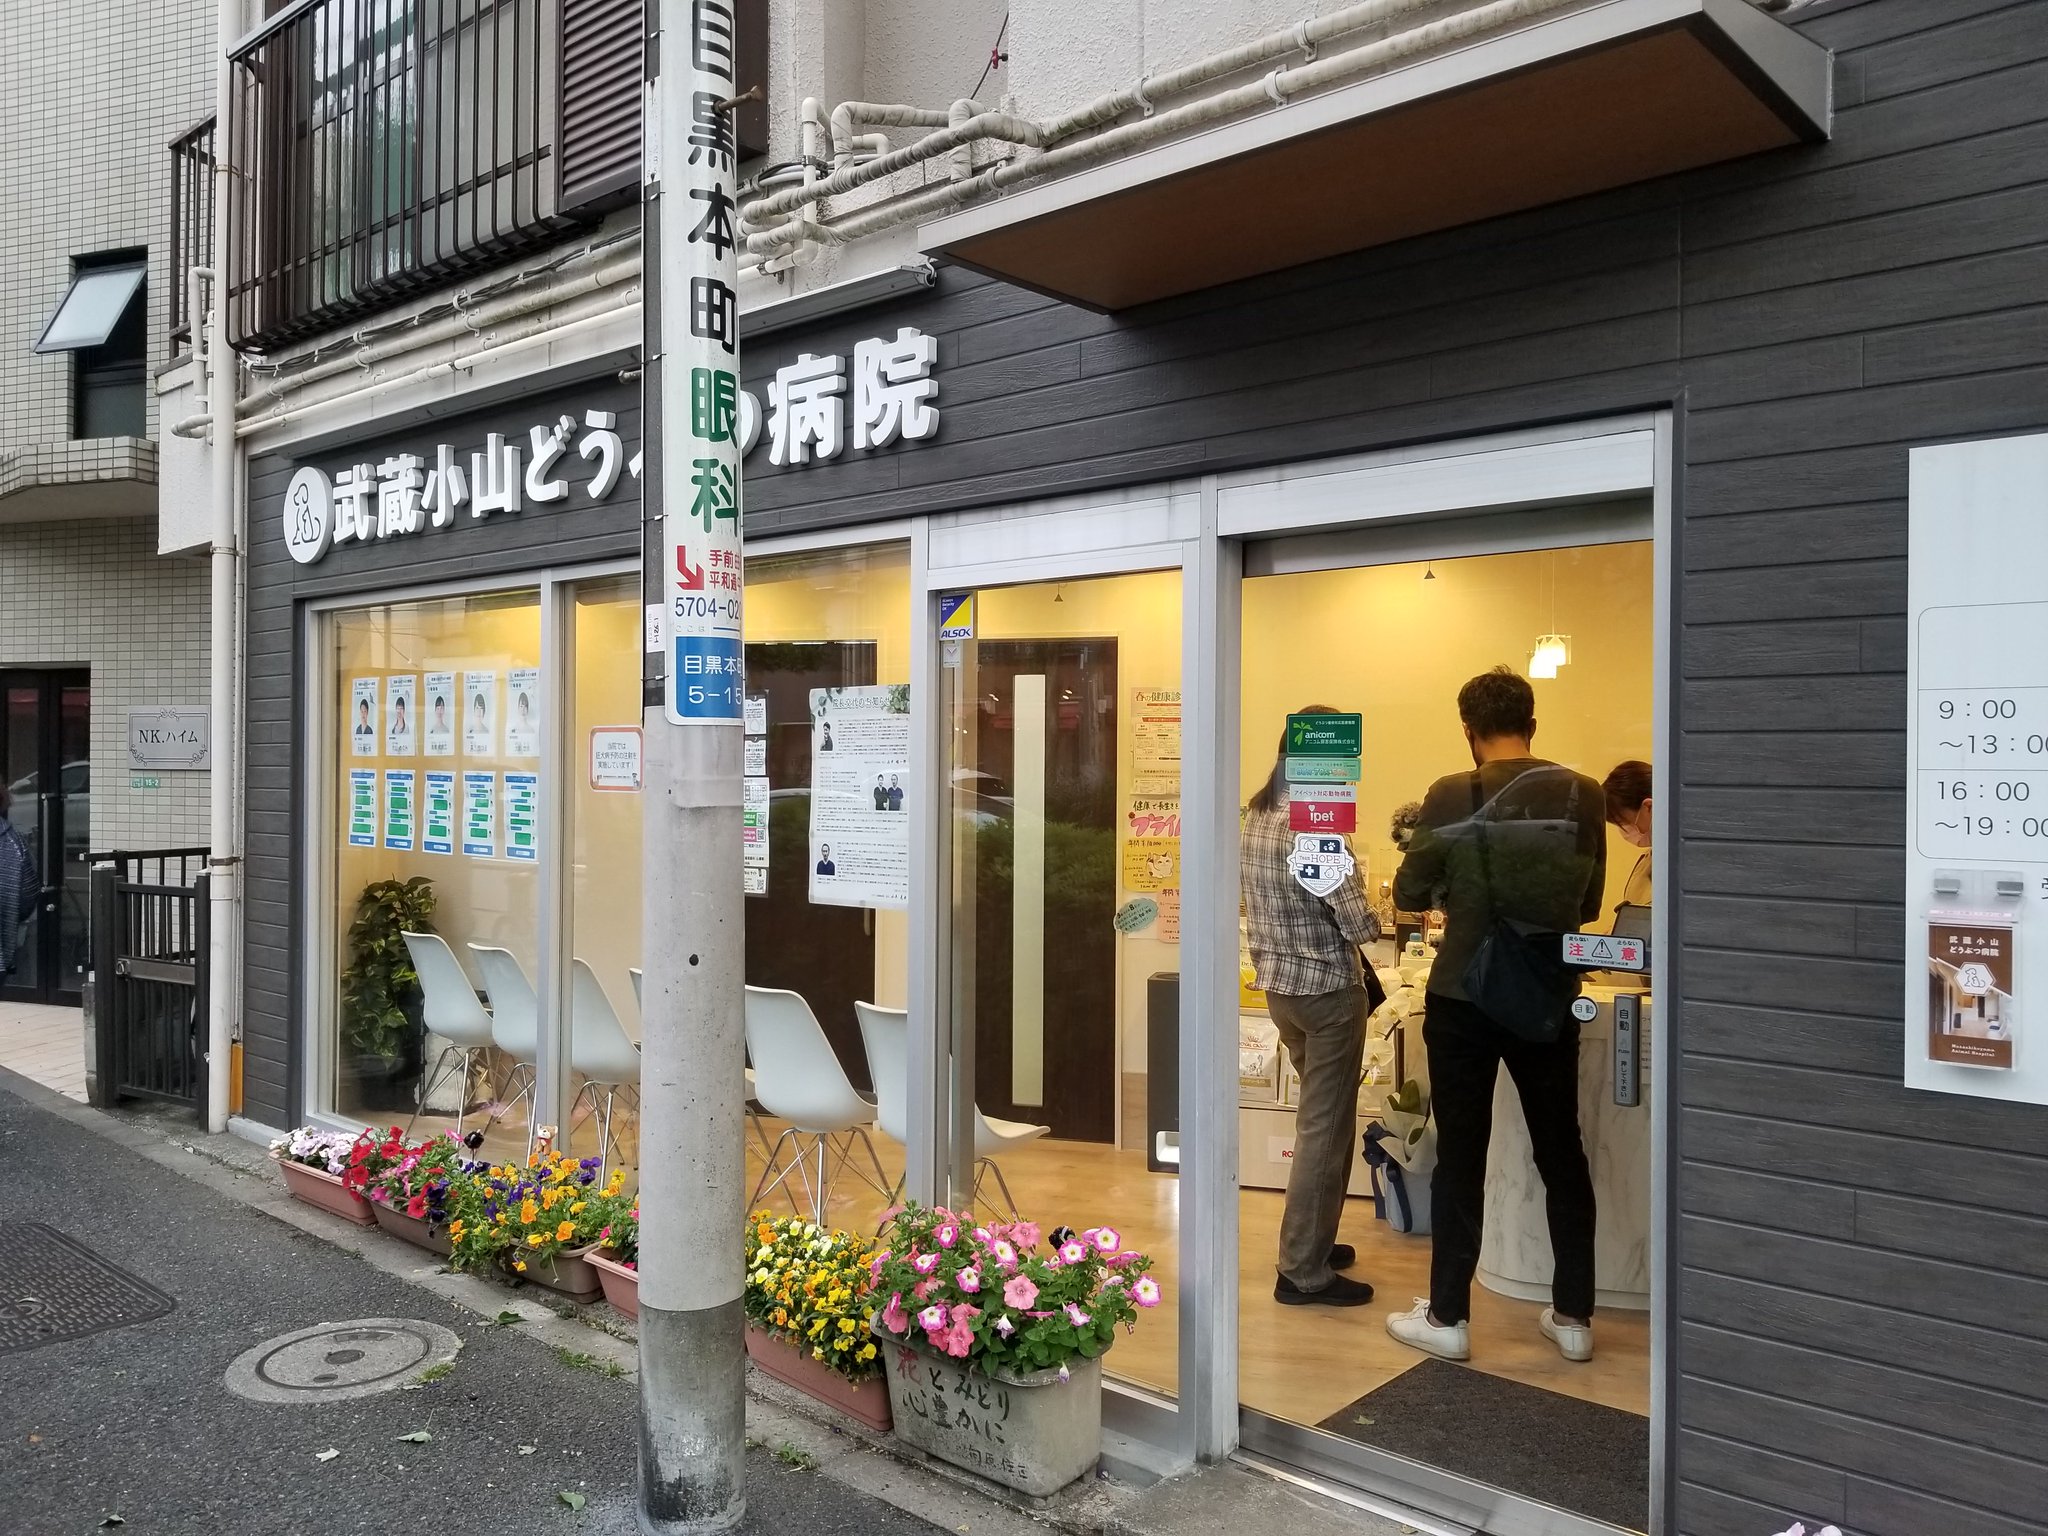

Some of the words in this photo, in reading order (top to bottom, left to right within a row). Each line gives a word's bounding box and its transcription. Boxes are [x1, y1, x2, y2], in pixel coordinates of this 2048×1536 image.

[331, 325, 942, 545] 武蔵小山どう病院
[708, 570, 741, 591] 平和通
[675, 597, 741, 620] 5704-02
[941, 629, 971, 639] ALSOK
[1304, 731, 1335, 739] anicom
[1938, 734, 2048, 755] ～13:0
[145, 778, 159, 787] 15-2
[1937, 780, 2031, 801] 16:00
[1311, 854, 1341, 864] HOPE
[1568, 942, 1584, 957] 注
[1621, 947, 1637, 961] 意
[1949, 946, 1999, 957] どうぶつ病院
[1619, 1008, 1630, 1027] 自動
